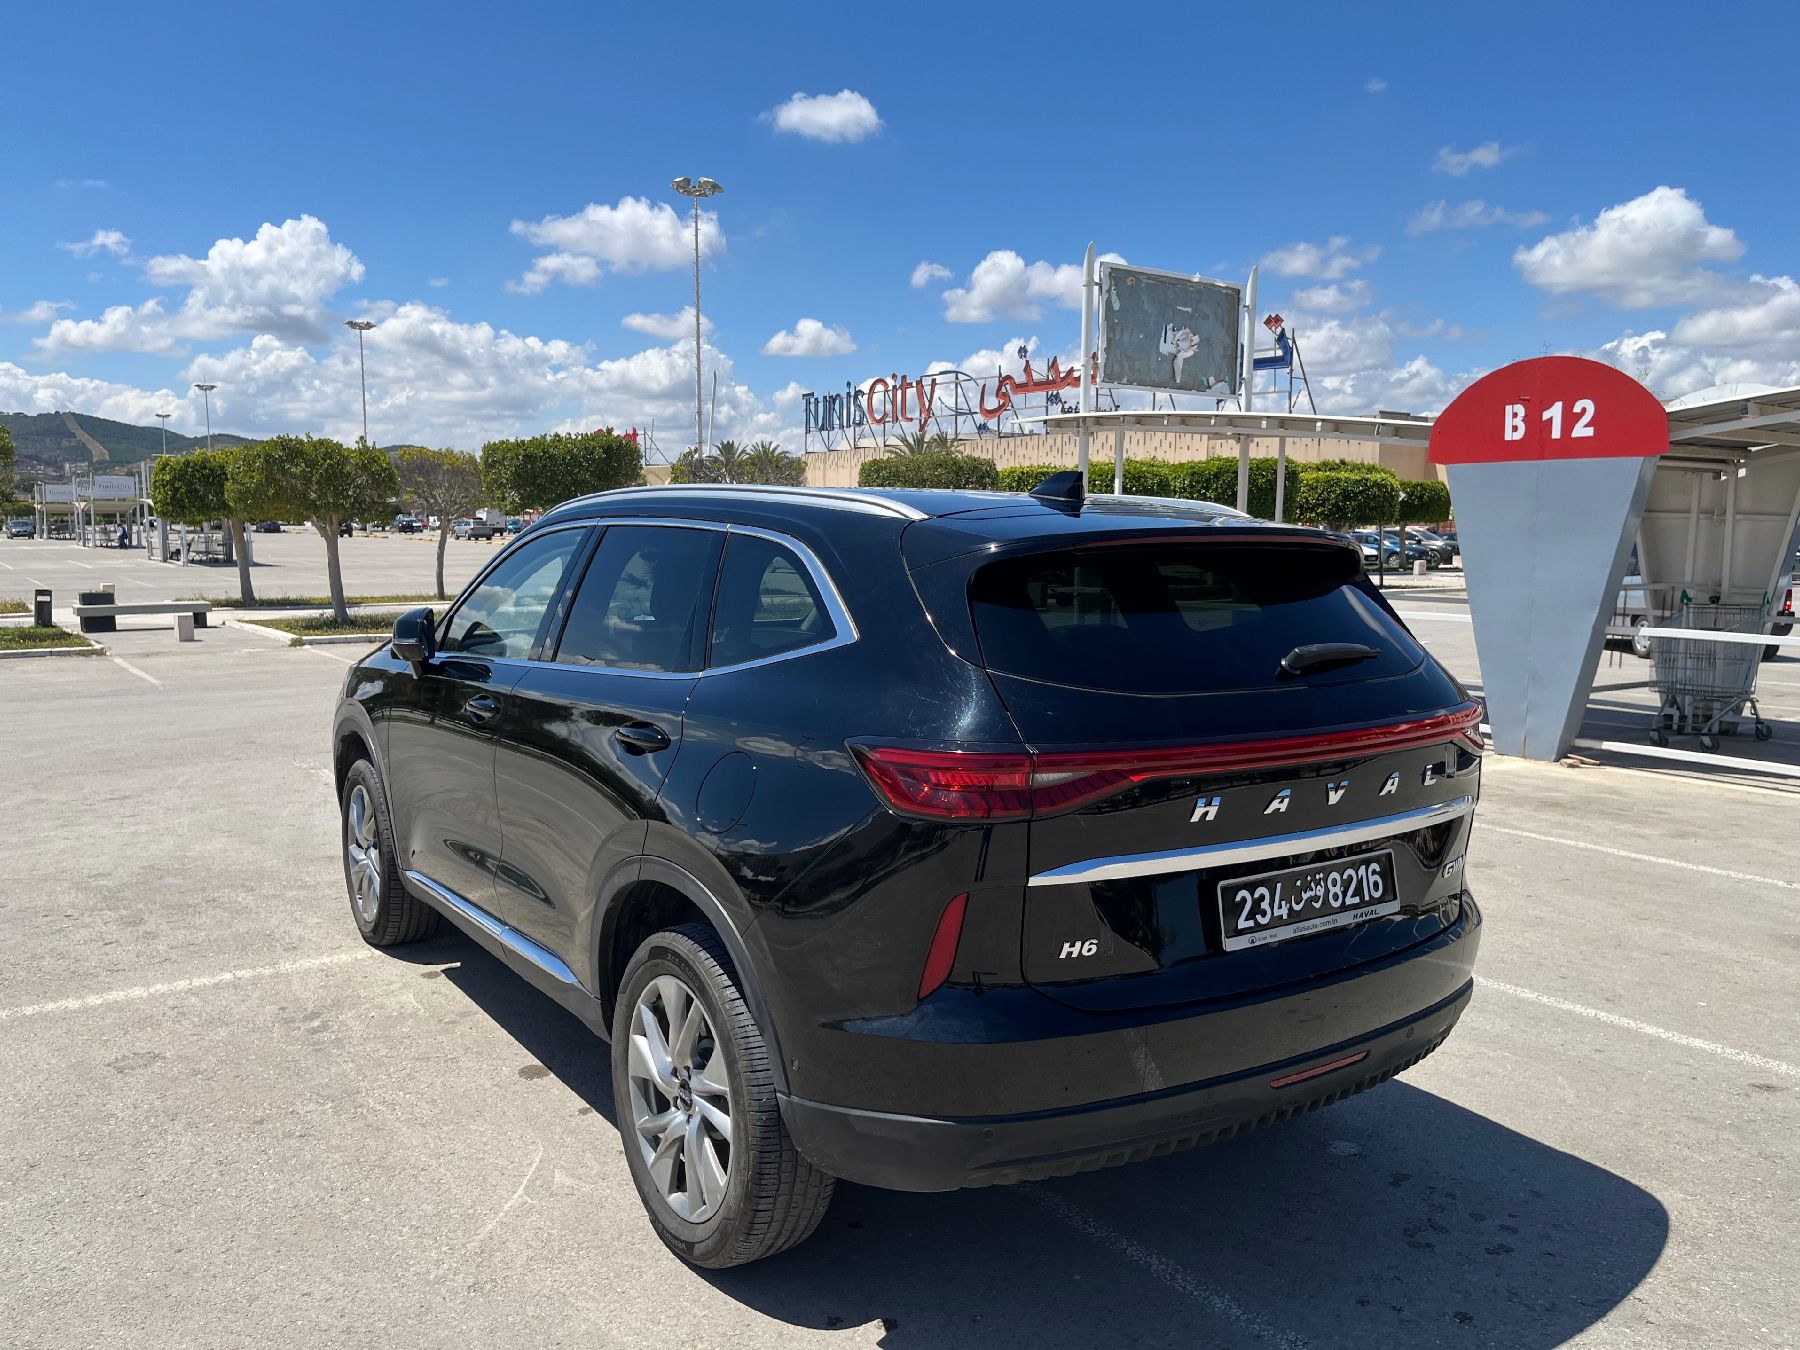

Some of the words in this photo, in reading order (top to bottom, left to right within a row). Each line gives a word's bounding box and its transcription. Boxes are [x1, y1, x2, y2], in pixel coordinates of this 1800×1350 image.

[1504, 403, 1526, 441] B
[1541, 398, 1595, 440] 12
[1189, 764, 1437, 823] HAVAL
[1235, 882, 1289, 930] 234
[1291, 871, 1326, 912] تونس
[1326, 862, 1384, 909] 8216
[1352, 908, 1380, 921] HAVAL
[1058, 938, 1099, 959] H6
